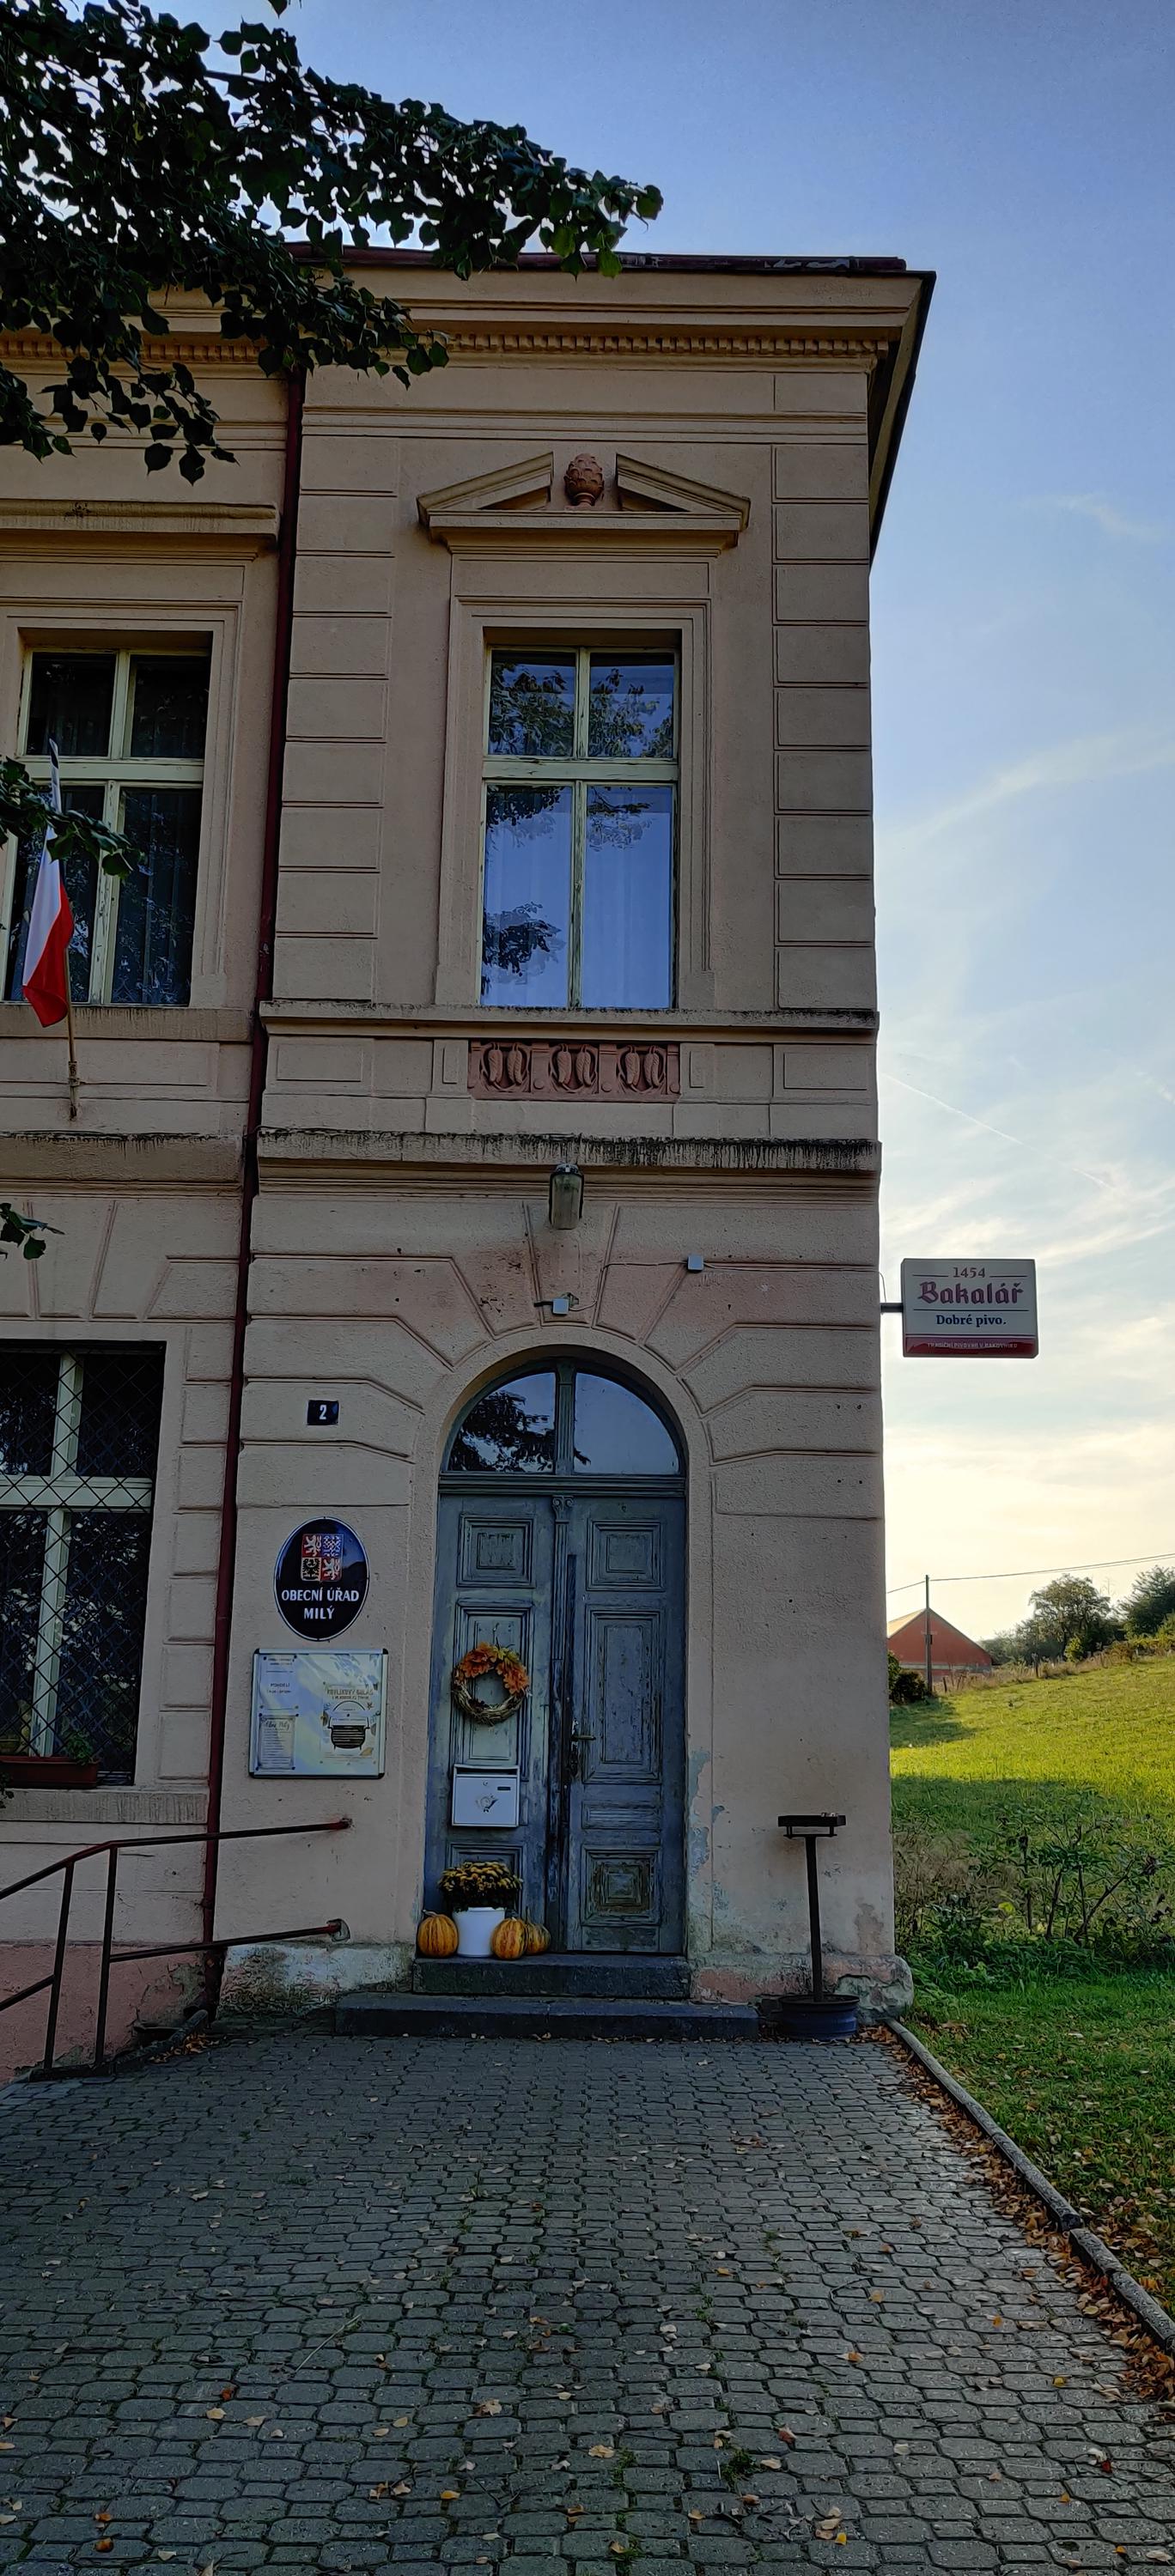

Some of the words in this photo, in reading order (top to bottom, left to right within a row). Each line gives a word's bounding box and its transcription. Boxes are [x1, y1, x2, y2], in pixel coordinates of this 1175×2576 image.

[953, 1267, 986, 1278] 1454
[917, 1281, 1024, 1304] Bakalář
[936, 1314, 972, 1325] Dobré
[976, 1315, 1007, 1327] pivo.
[320, 1404, 326, 1420] 2
[281, 1587, 323, 1601] OBECNÍ
[326, 1587, 360, 1601] ÚŘAD
[303, 1605, 335, 1619] MILÝ
